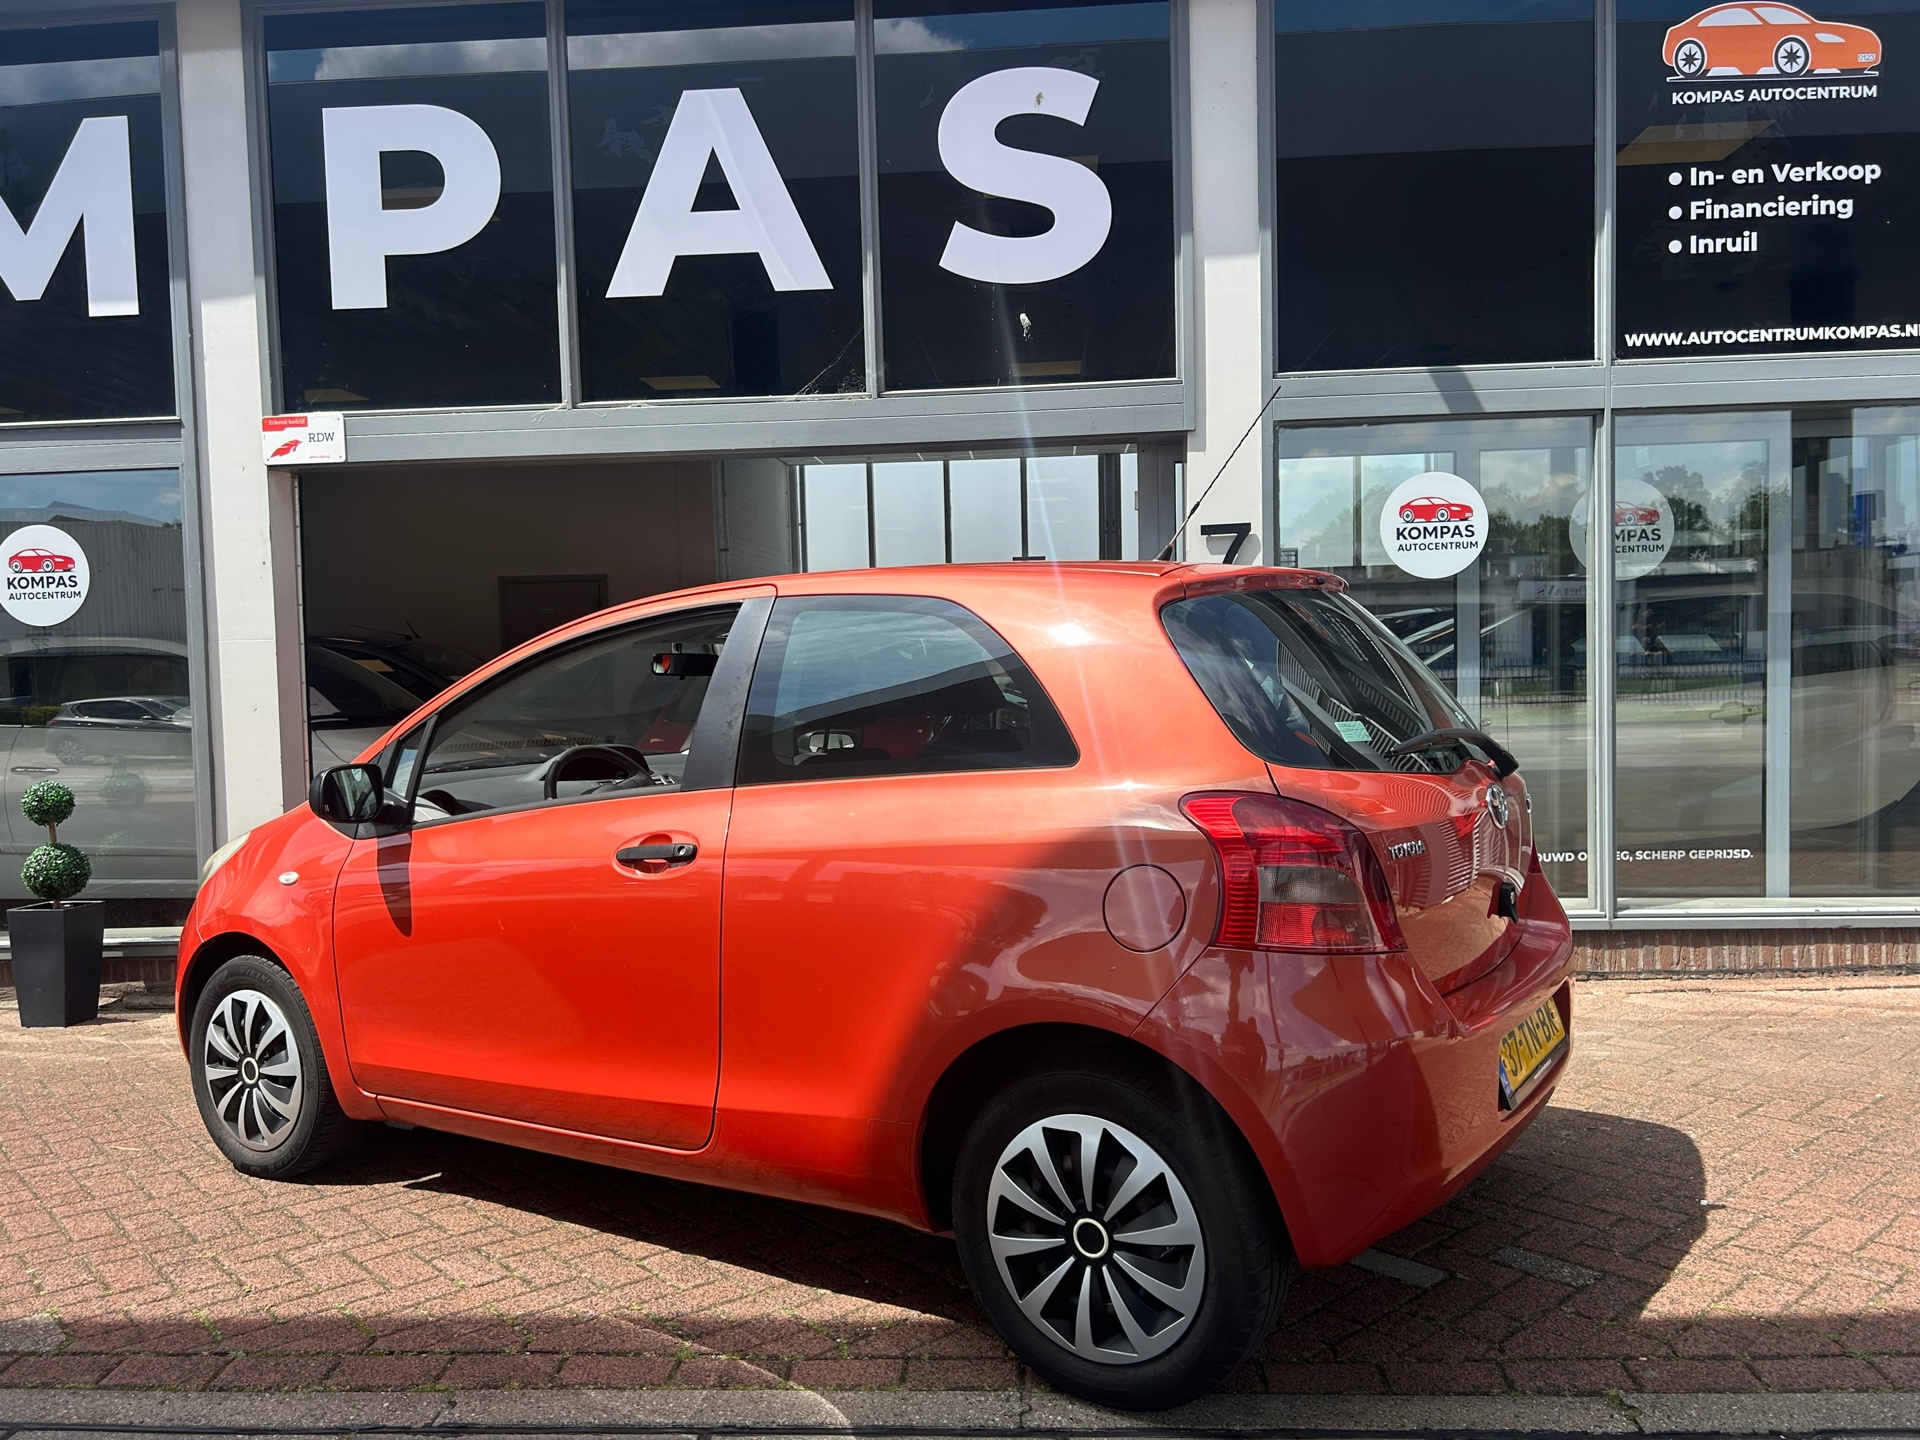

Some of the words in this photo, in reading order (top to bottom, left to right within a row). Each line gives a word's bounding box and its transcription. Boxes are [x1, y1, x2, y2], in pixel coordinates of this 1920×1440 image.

[1671, 89, 1744, 105] KOMPAS
[1748, 85, 1878, 102] AUTOCENTRUM
[1690, 167, 1725, 186] In-
[1731, 167, 1764, 184] en
[1771, 161, 1882, 184] Verkoop
[1690, 194, 1854, 220] Financiering
[1690, 231, 1758, 254] Inruil
[1625, 323, 1920, 347] WWW.AUTOCENTRUMKOMPAS.N
[308, 432, 335, 442] RDW
[1396, 524, 1475, 540] KOMPAS
[1615, 528, 1662, 542] MPAS
[1201, 522, 1251, 564] 7
[1397, 541, 1479, 552] AUTOCENTRUM
[1615, 544, 1665, 553] CENTRUM
[7, 575, 78, 590] KOMPAS
[9, 591, 81, 600] AUTOCENTRUM
[1388, 840, 1425, 860] TOYOTA
[1635, 850, 1686, 861] SCHERP
[1689, 848, 1754, 860] GEPRIJSD.
[240, 966, 272, 985] VIKING
[1501, 1001, 1560, 1077] 37-TN-BK
